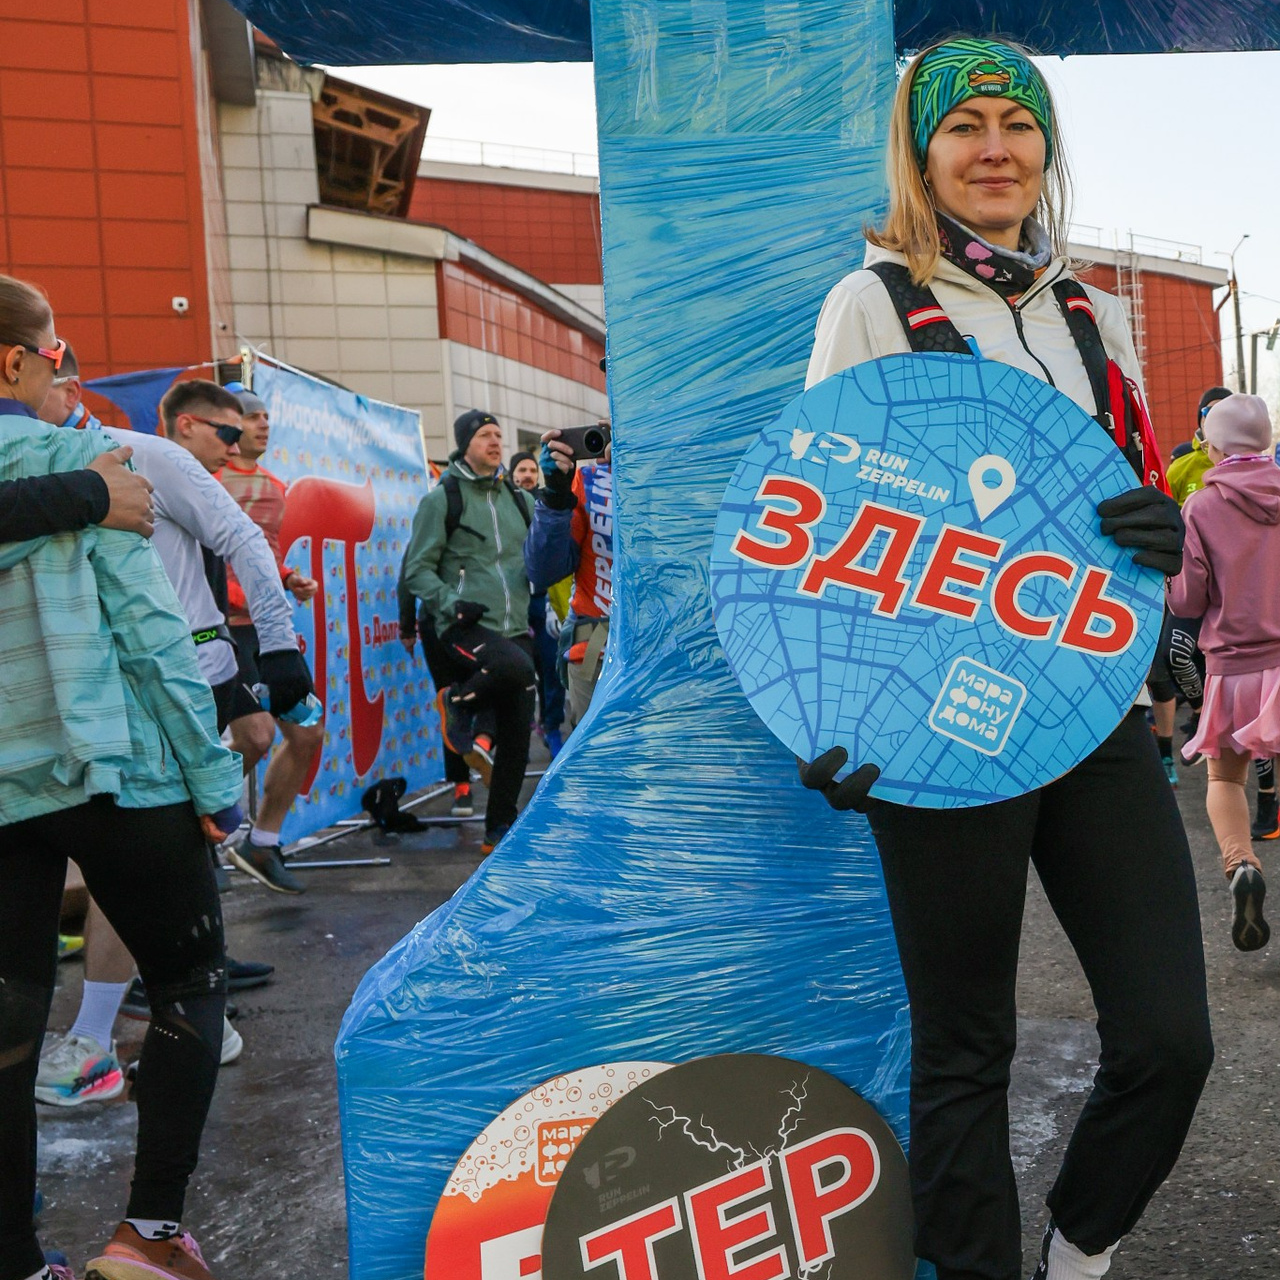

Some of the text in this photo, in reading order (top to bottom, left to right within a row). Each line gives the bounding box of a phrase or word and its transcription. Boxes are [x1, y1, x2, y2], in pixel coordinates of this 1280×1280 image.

[865, 449, 909, 472] RUN
[856, 465, 950, 503] ZEPPELIN
[730, 474, 1138, 657] ЗДЕСЬ
[949, 685, 1009, 725] фону
[957, 669, 1013, 705] мара
[938, 705, 998, 741] дома
[600, 1184, 650, 1212] ZEPPELIN
